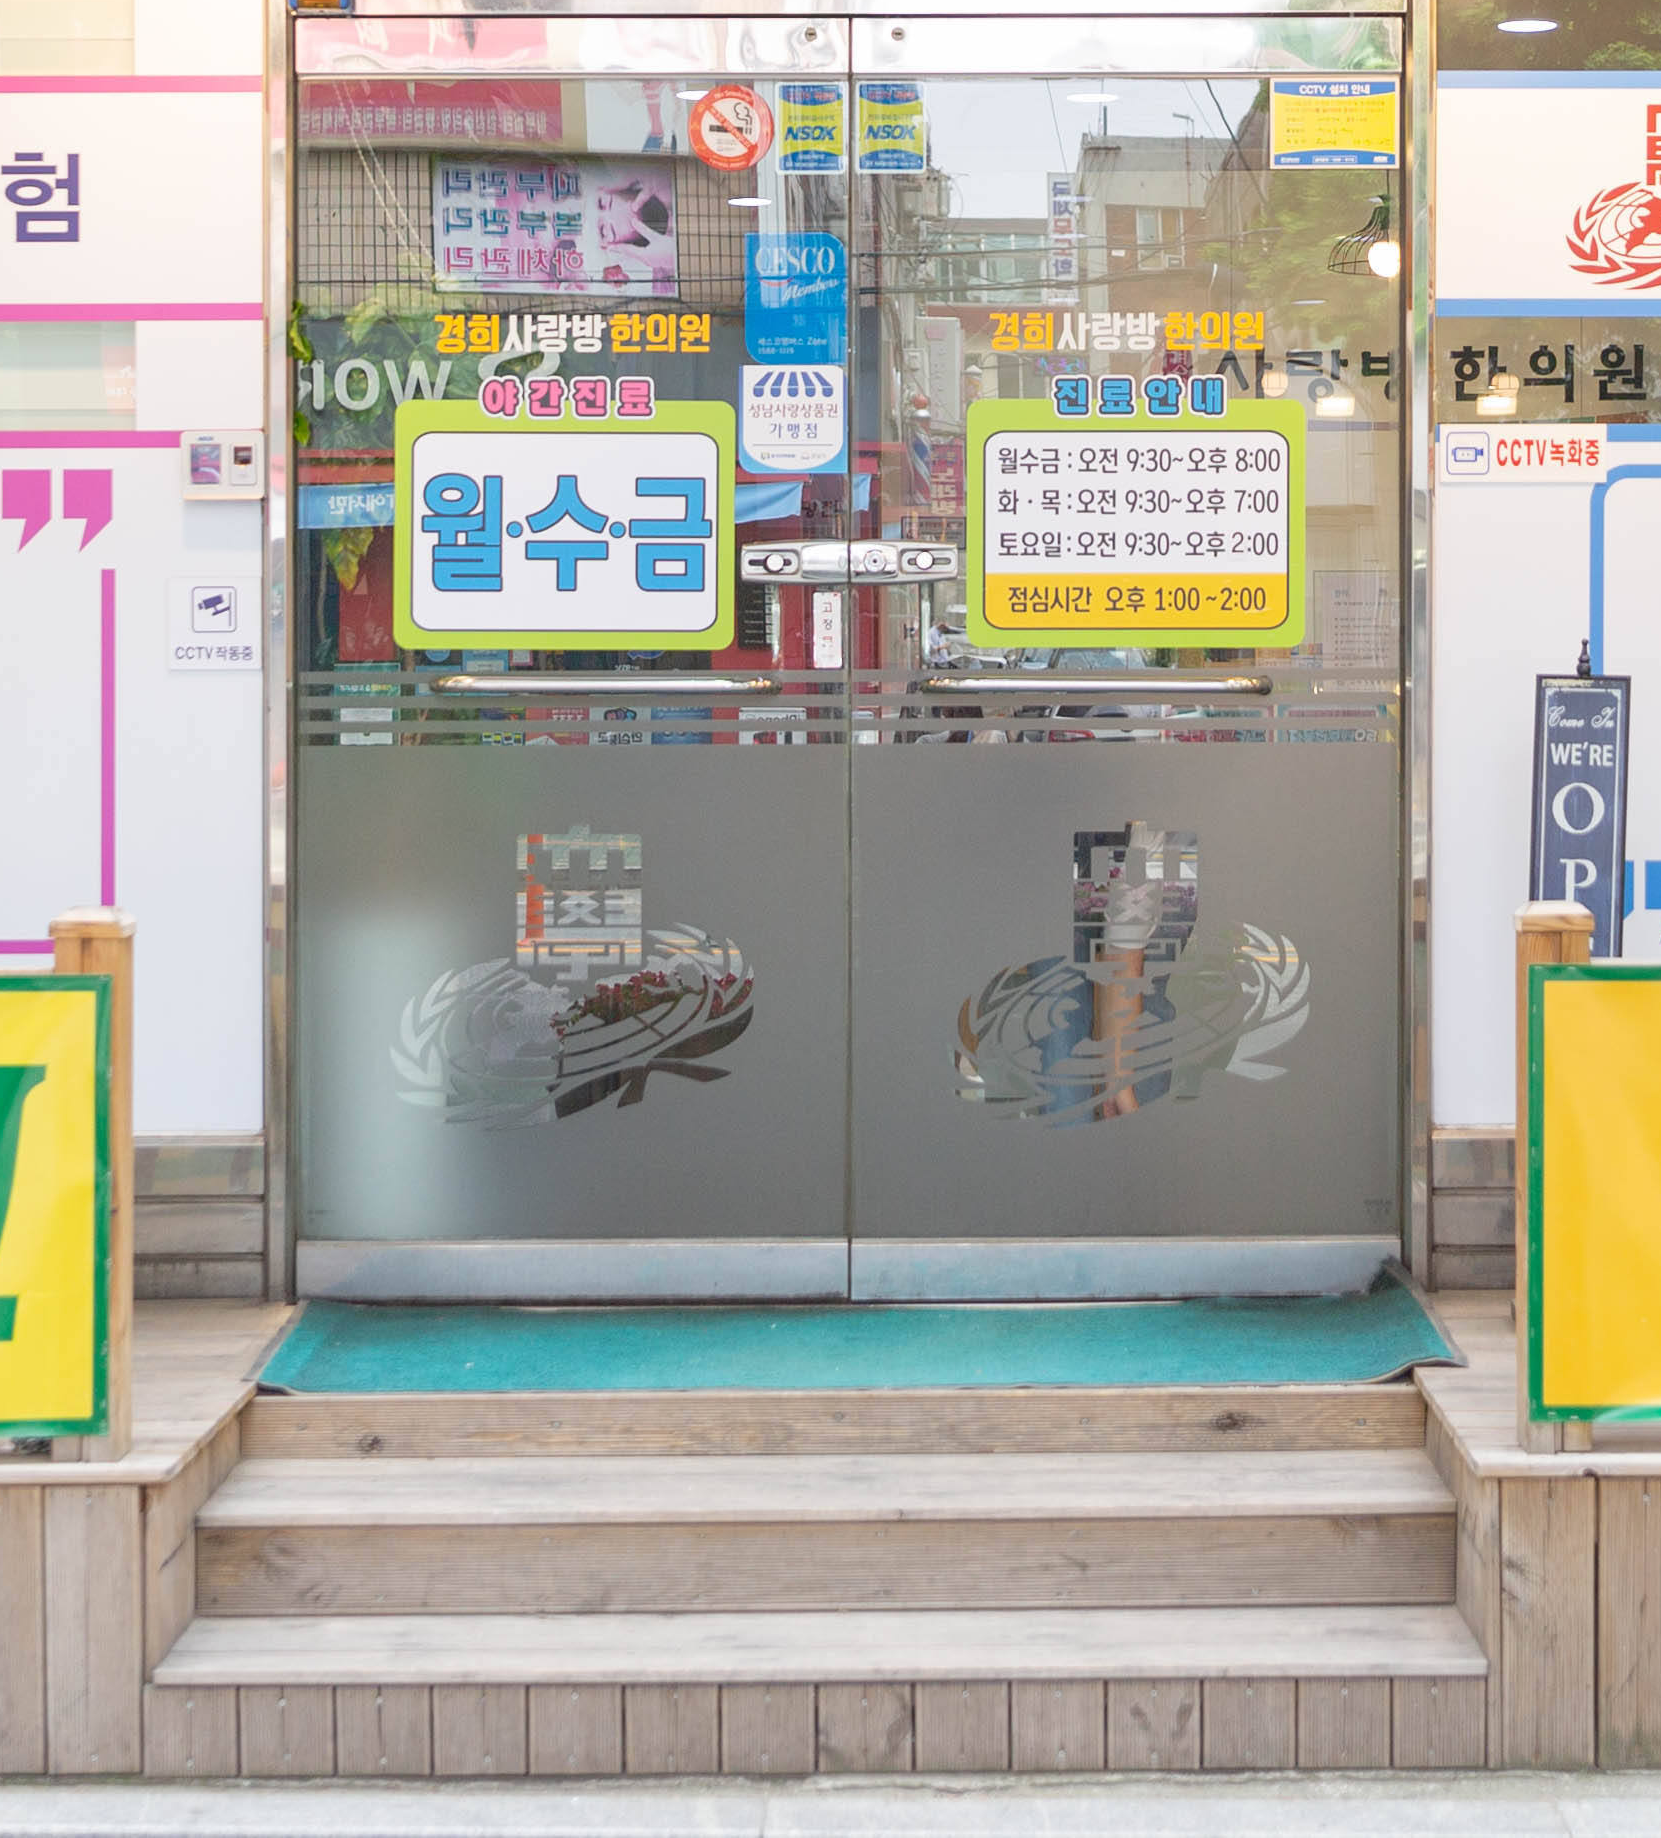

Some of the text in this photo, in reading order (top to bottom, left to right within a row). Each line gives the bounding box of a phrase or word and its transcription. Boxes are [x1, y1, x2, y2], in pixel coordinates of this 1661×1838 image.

[1299, 84, 1327, 95] CCTV
[785, 124, 837, 141] NSOK
[866, 124, 916, 140] NSOK
[755, 247, 835, 276] CESCO
[483, 378, 651, 417] 야간진료
[1053, 377, 1225, 416] 진료안내
[749, 403, 838, 419] 성남사랑상품권
[770, 422, 818, 439] 가맹점
[1235, 448, 1281, 474] 8:00
[1495, 437, 1601, 470] CCTV녹화중
[1235, 490, 1280, 515] 7:00
[1232, 532, 1280, 557] 2:00
[1008, 586, 1092, 614] 점심시간
[1105, 586, 1146, 613] 오후
[1547, 705, 1585, 729] Come
